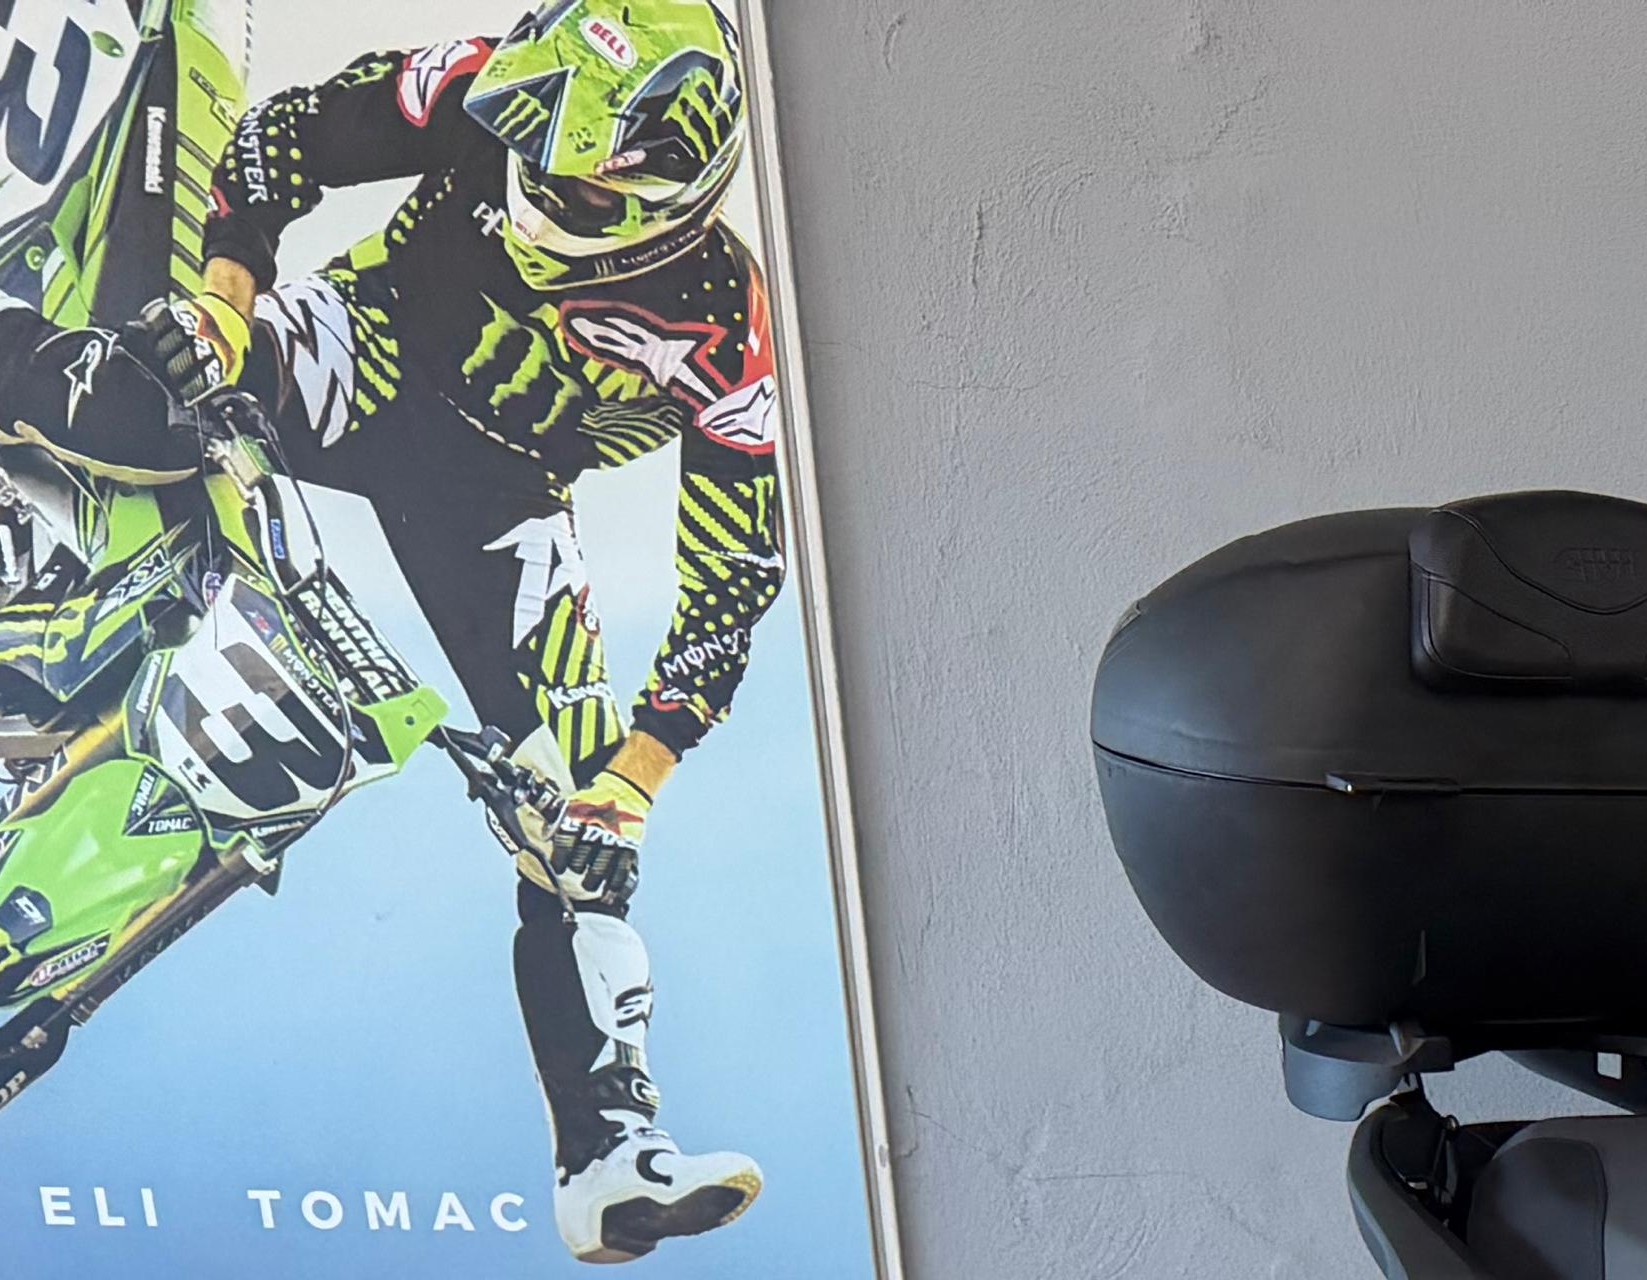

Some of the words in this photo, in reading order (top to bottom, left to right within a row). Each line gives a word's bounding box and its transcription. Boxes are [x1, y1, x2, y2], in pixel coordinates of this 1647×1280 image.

[588, 21, 627, 60] BELL
[144, 105, 167, 195] Kawasaki
[160, 642, 348, 812] 3
[147, 816, 193, 834] TOMAC
[40, 1186, 158, 1227] ELI
[247, 1188, 530, 1232] TOMAC
